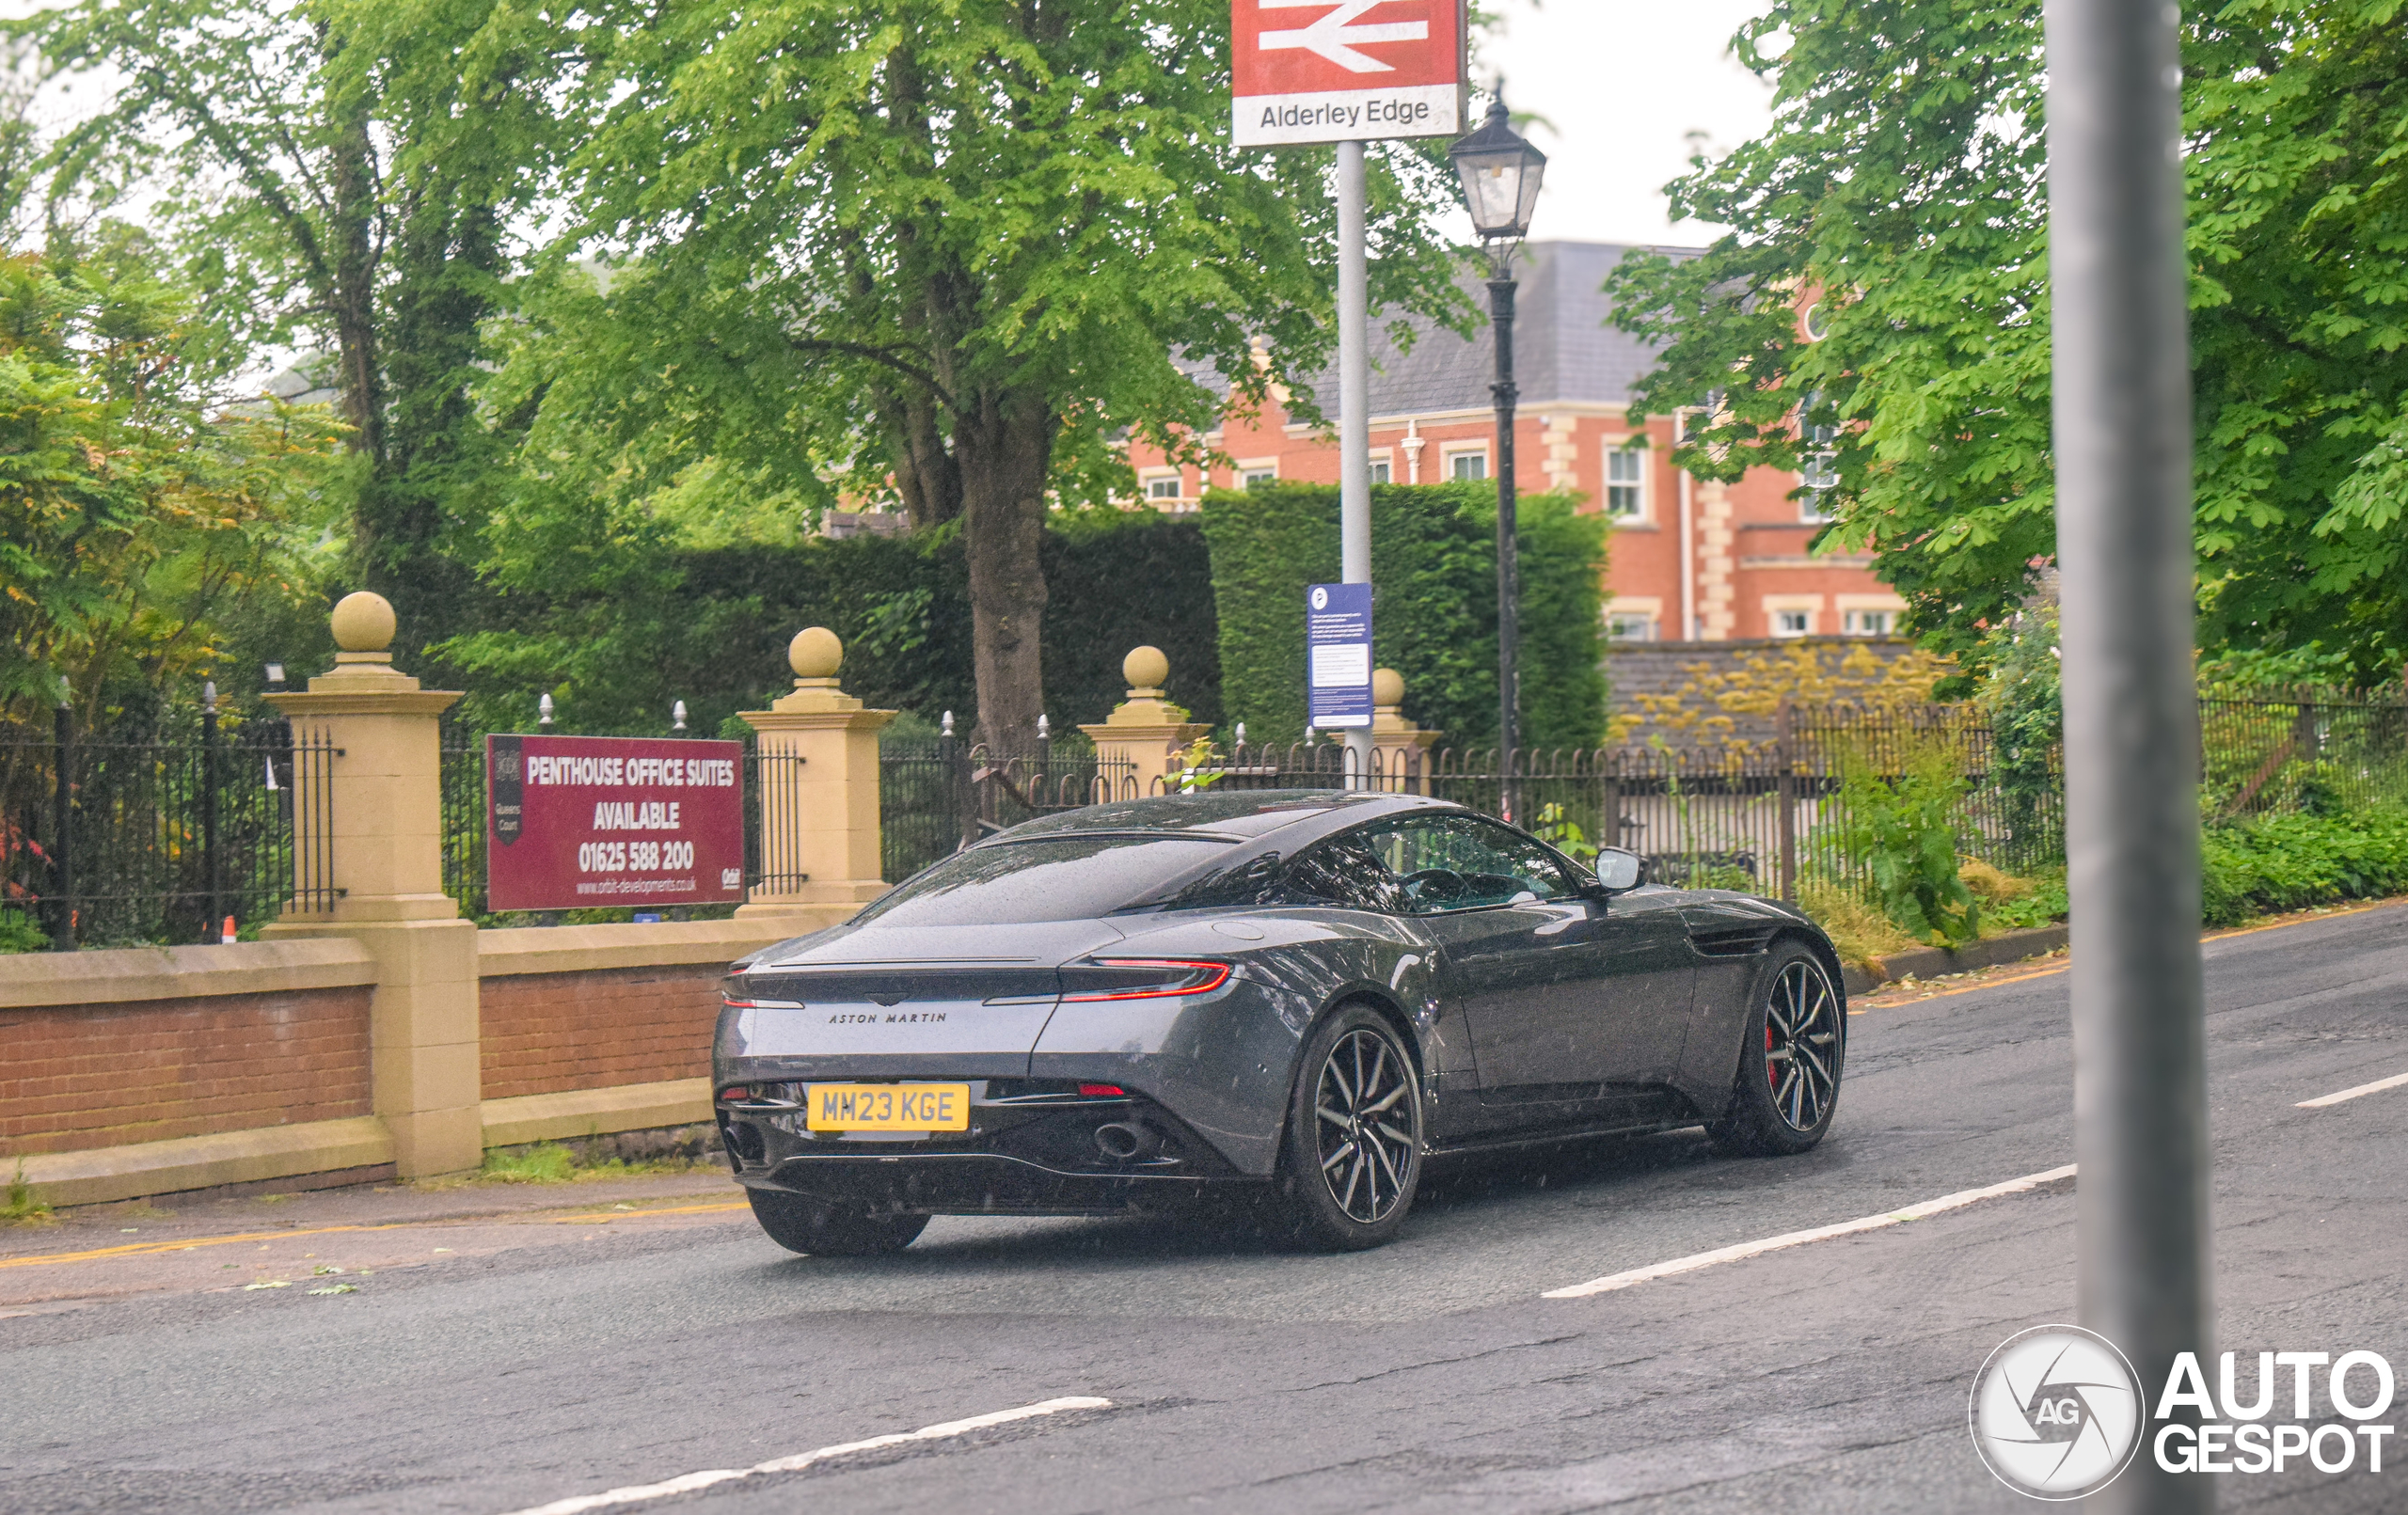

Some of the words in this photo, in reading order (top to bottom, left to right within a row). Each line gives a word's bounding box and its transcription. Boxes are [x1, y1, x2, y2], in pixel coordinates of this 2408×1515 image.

[1260, 101, 1360, 128] Alderley
[1367, 99, 1429, 124] Edge
[528, 756, 624, 785] PENTHOUSE
[626, 758, 683, 786] OFFICE
[686, 760, 734, 786] SUITES
[594, 802, 680, 829] AVAILABLE
[578, 842, 626, 872] 01625
[628, 841, 659, 871] 588
[662, 840, 694, 871] 200
[577, 876, 697, 894] www.orbit-developments.co.uk
[829, 1014, 878, 1024] ASTON
[885, 1012, 947, 1023] MARTIN
[822, 1092, 893, 1121] MM23
[901, 1092, 954, 1121] KGE
